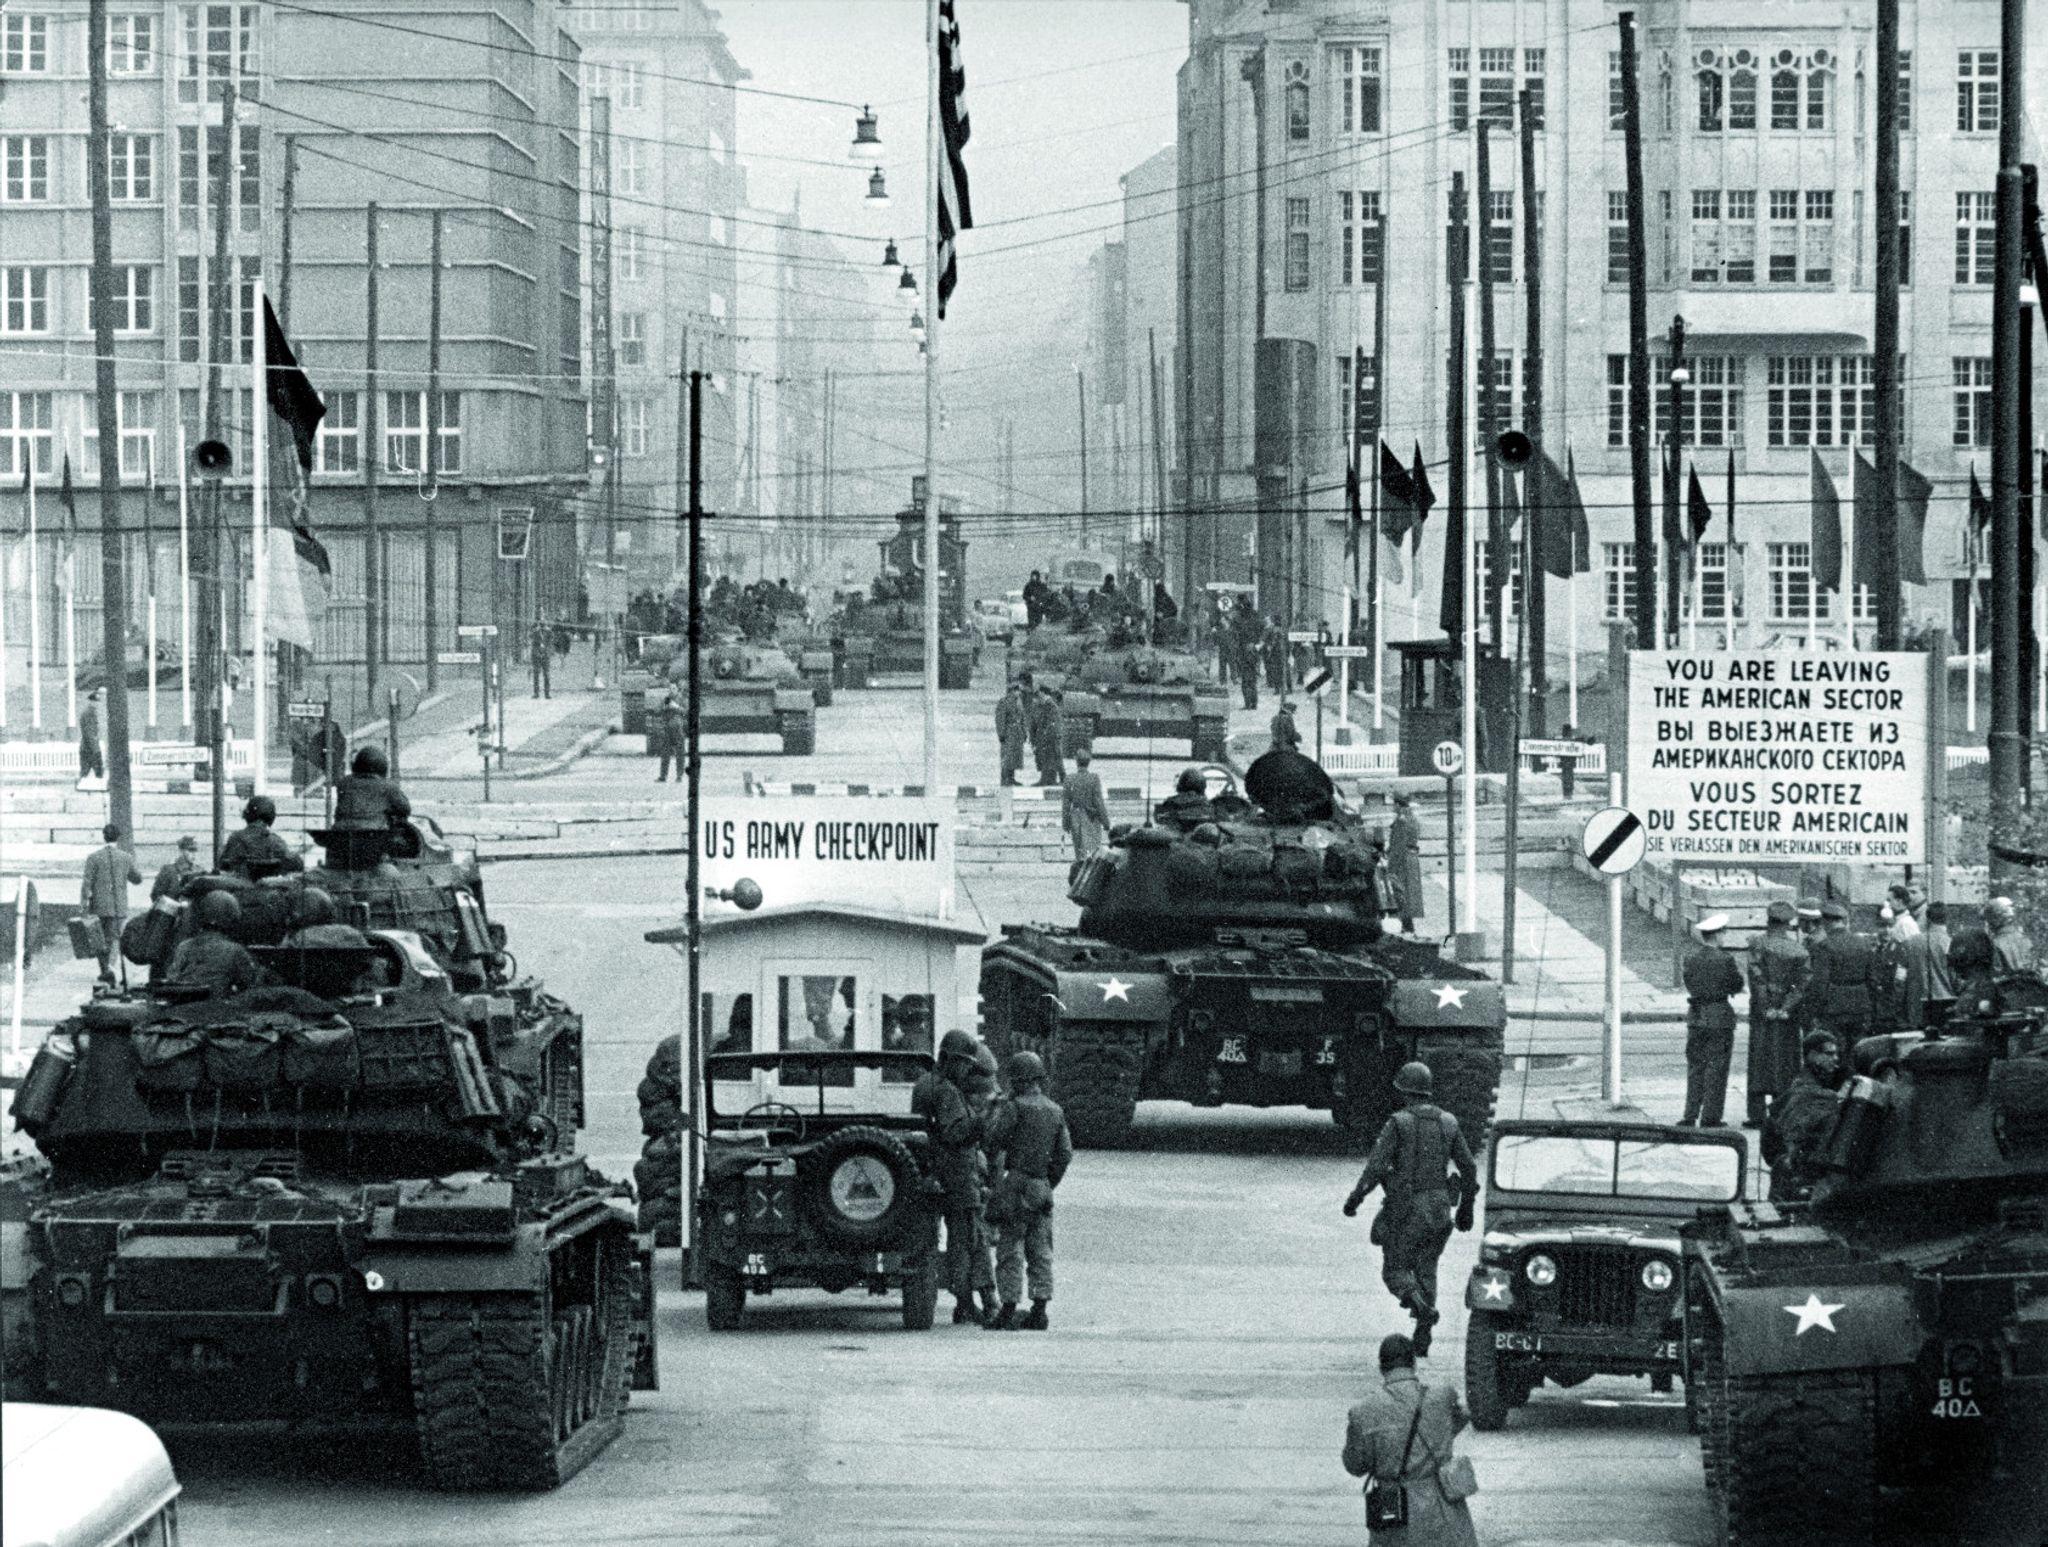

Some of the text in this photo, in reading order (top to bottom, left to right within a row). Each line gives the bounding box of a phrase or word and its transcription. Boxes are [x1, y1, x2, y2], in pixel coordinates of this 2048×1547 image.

[1666, 658, 1890, 683] YOU ARE LEAVING
[1653, 686, 1903, 711] THE AMERICAN SECTOR
[1657, 719, 1899, 744] ВЫ ВЫЕЗЖАЕТЕ ИЗ
[1437, 746, 1453, 767] 10
[1652, 748, 1906, 771] АМЕРИКАНСКОГО СЕКТОРА
[1690, 781, 1862, 805] VOUS SORTEZ
[1648, 809, 1908, 834] DU SECTEUR AMERICAIN
[705, 820, 939, 861] US ARMY CHECKPOINT
[1647, 836, 1908, 856] SIE VERLASSEN DEN AMERIKANISCHEN SEKTOR
